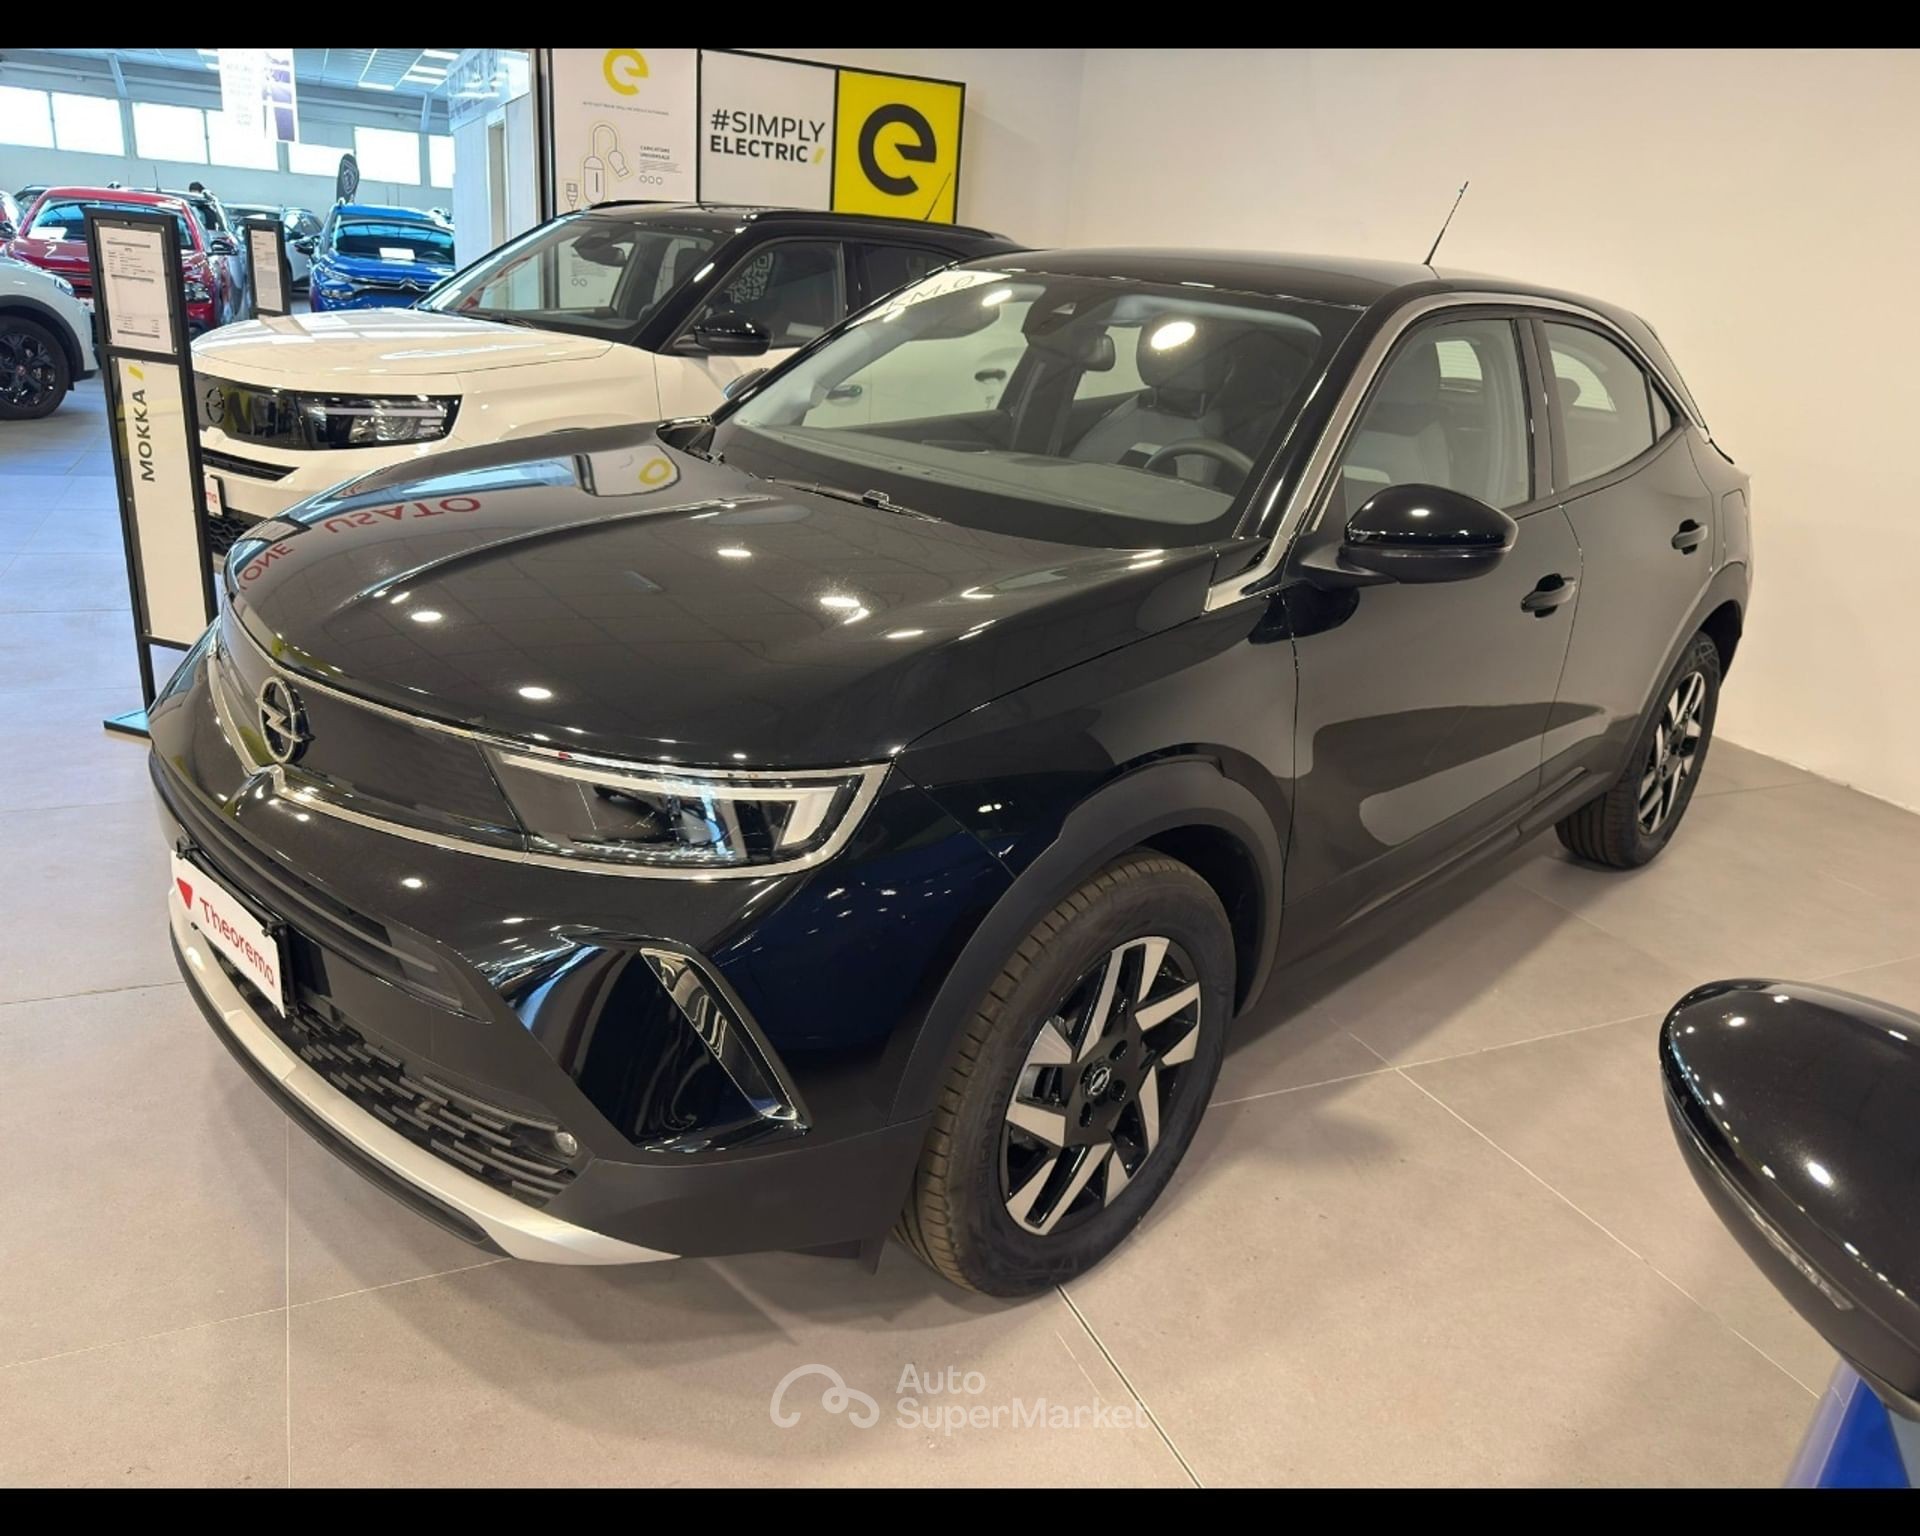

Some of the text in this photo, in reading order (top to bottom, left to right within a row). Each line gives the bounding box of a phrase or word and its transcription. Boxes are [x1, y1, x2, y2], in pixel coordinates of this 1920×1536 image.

[710, 134, 808, 163] ELECTRIC
[711, 108, 826, 143] #SIMPLY
[858, 103, 937, 195] e
[132, 389, 156, 482] MOKKA
[200, 897, 275, 989] Theorema
